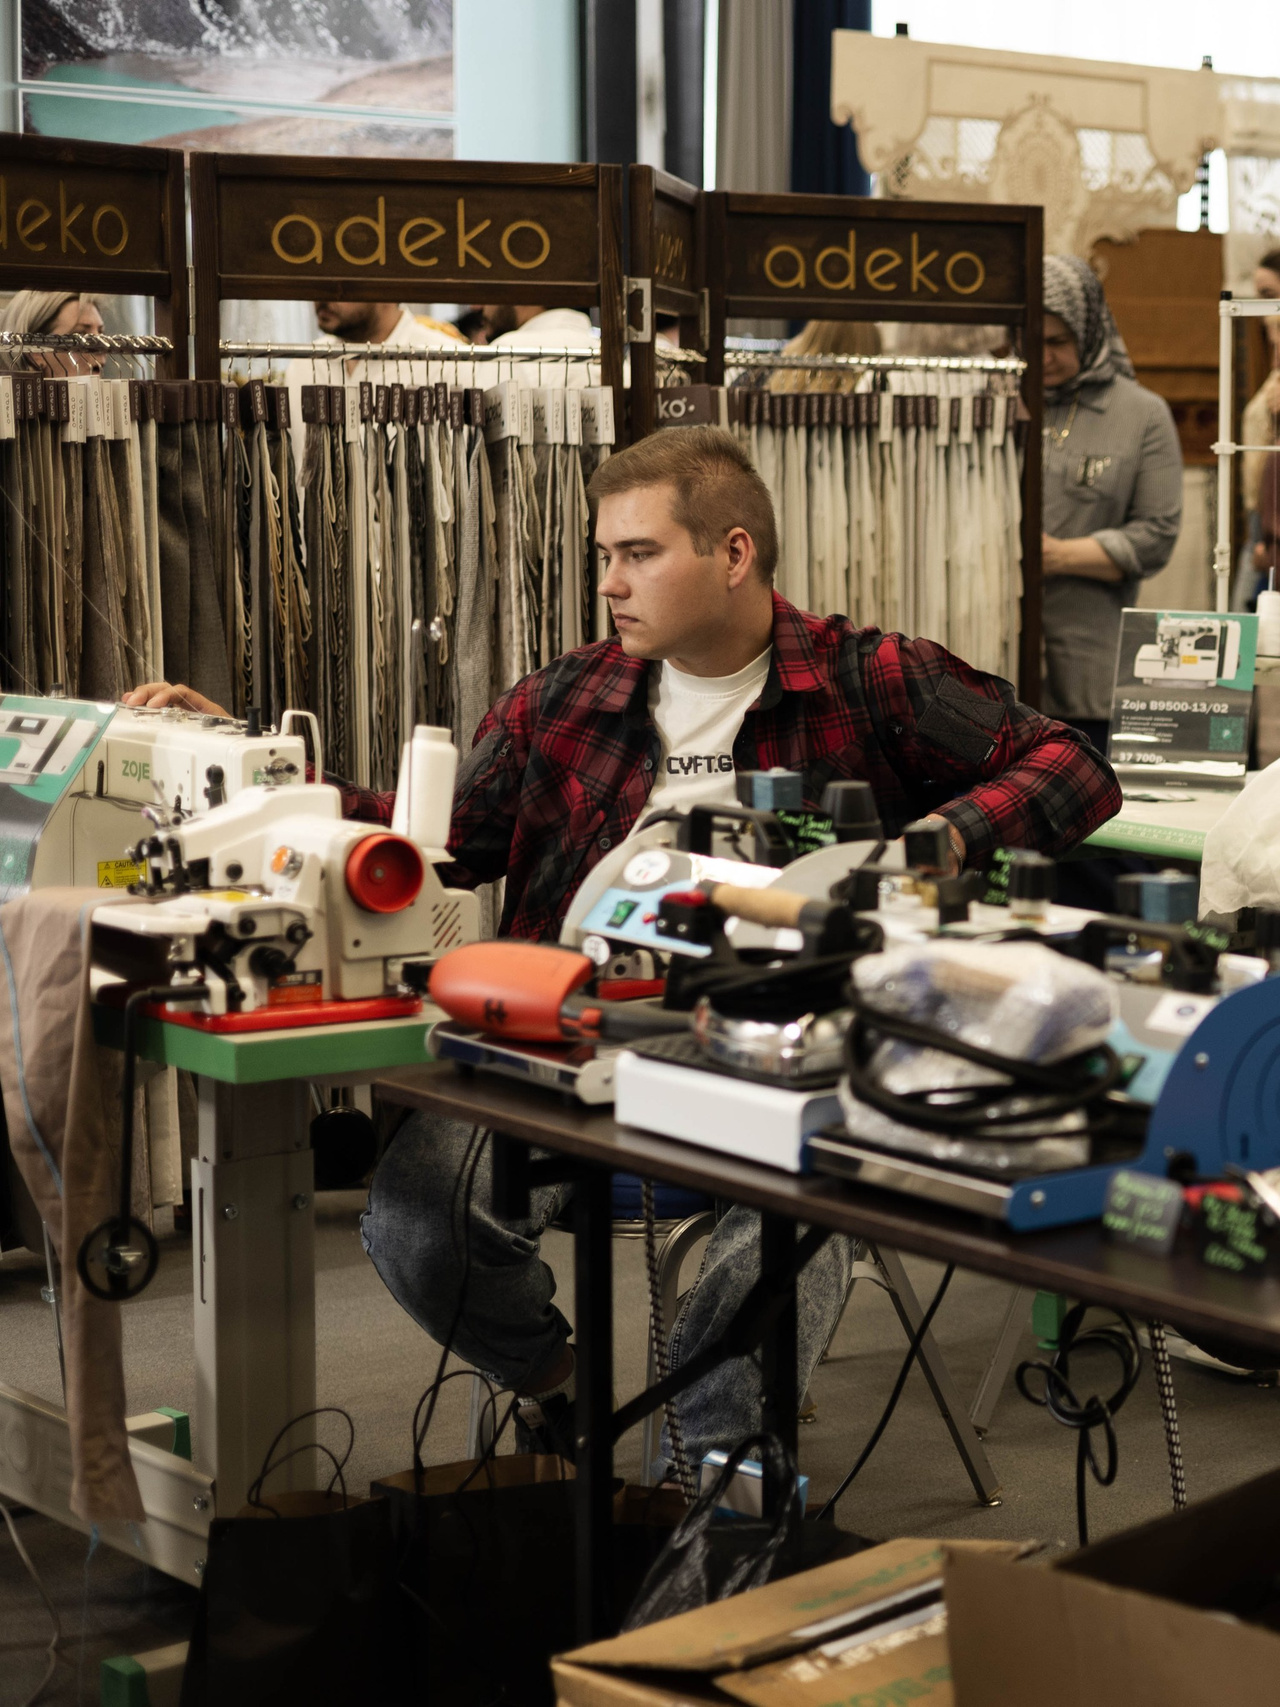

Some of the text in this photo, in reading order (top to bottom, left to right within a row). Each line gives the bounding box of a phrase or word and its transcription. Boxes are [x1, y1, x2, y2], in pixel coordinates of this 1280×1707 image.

[0, 174, 129, 256] eko
[271, 196, 551, 269] adeko
[764, 229, 986, 296] adeko
[1121, 699, 1229, 715] Zoje B9500-13/02
[121, 759, 151, 782] ZOJE
